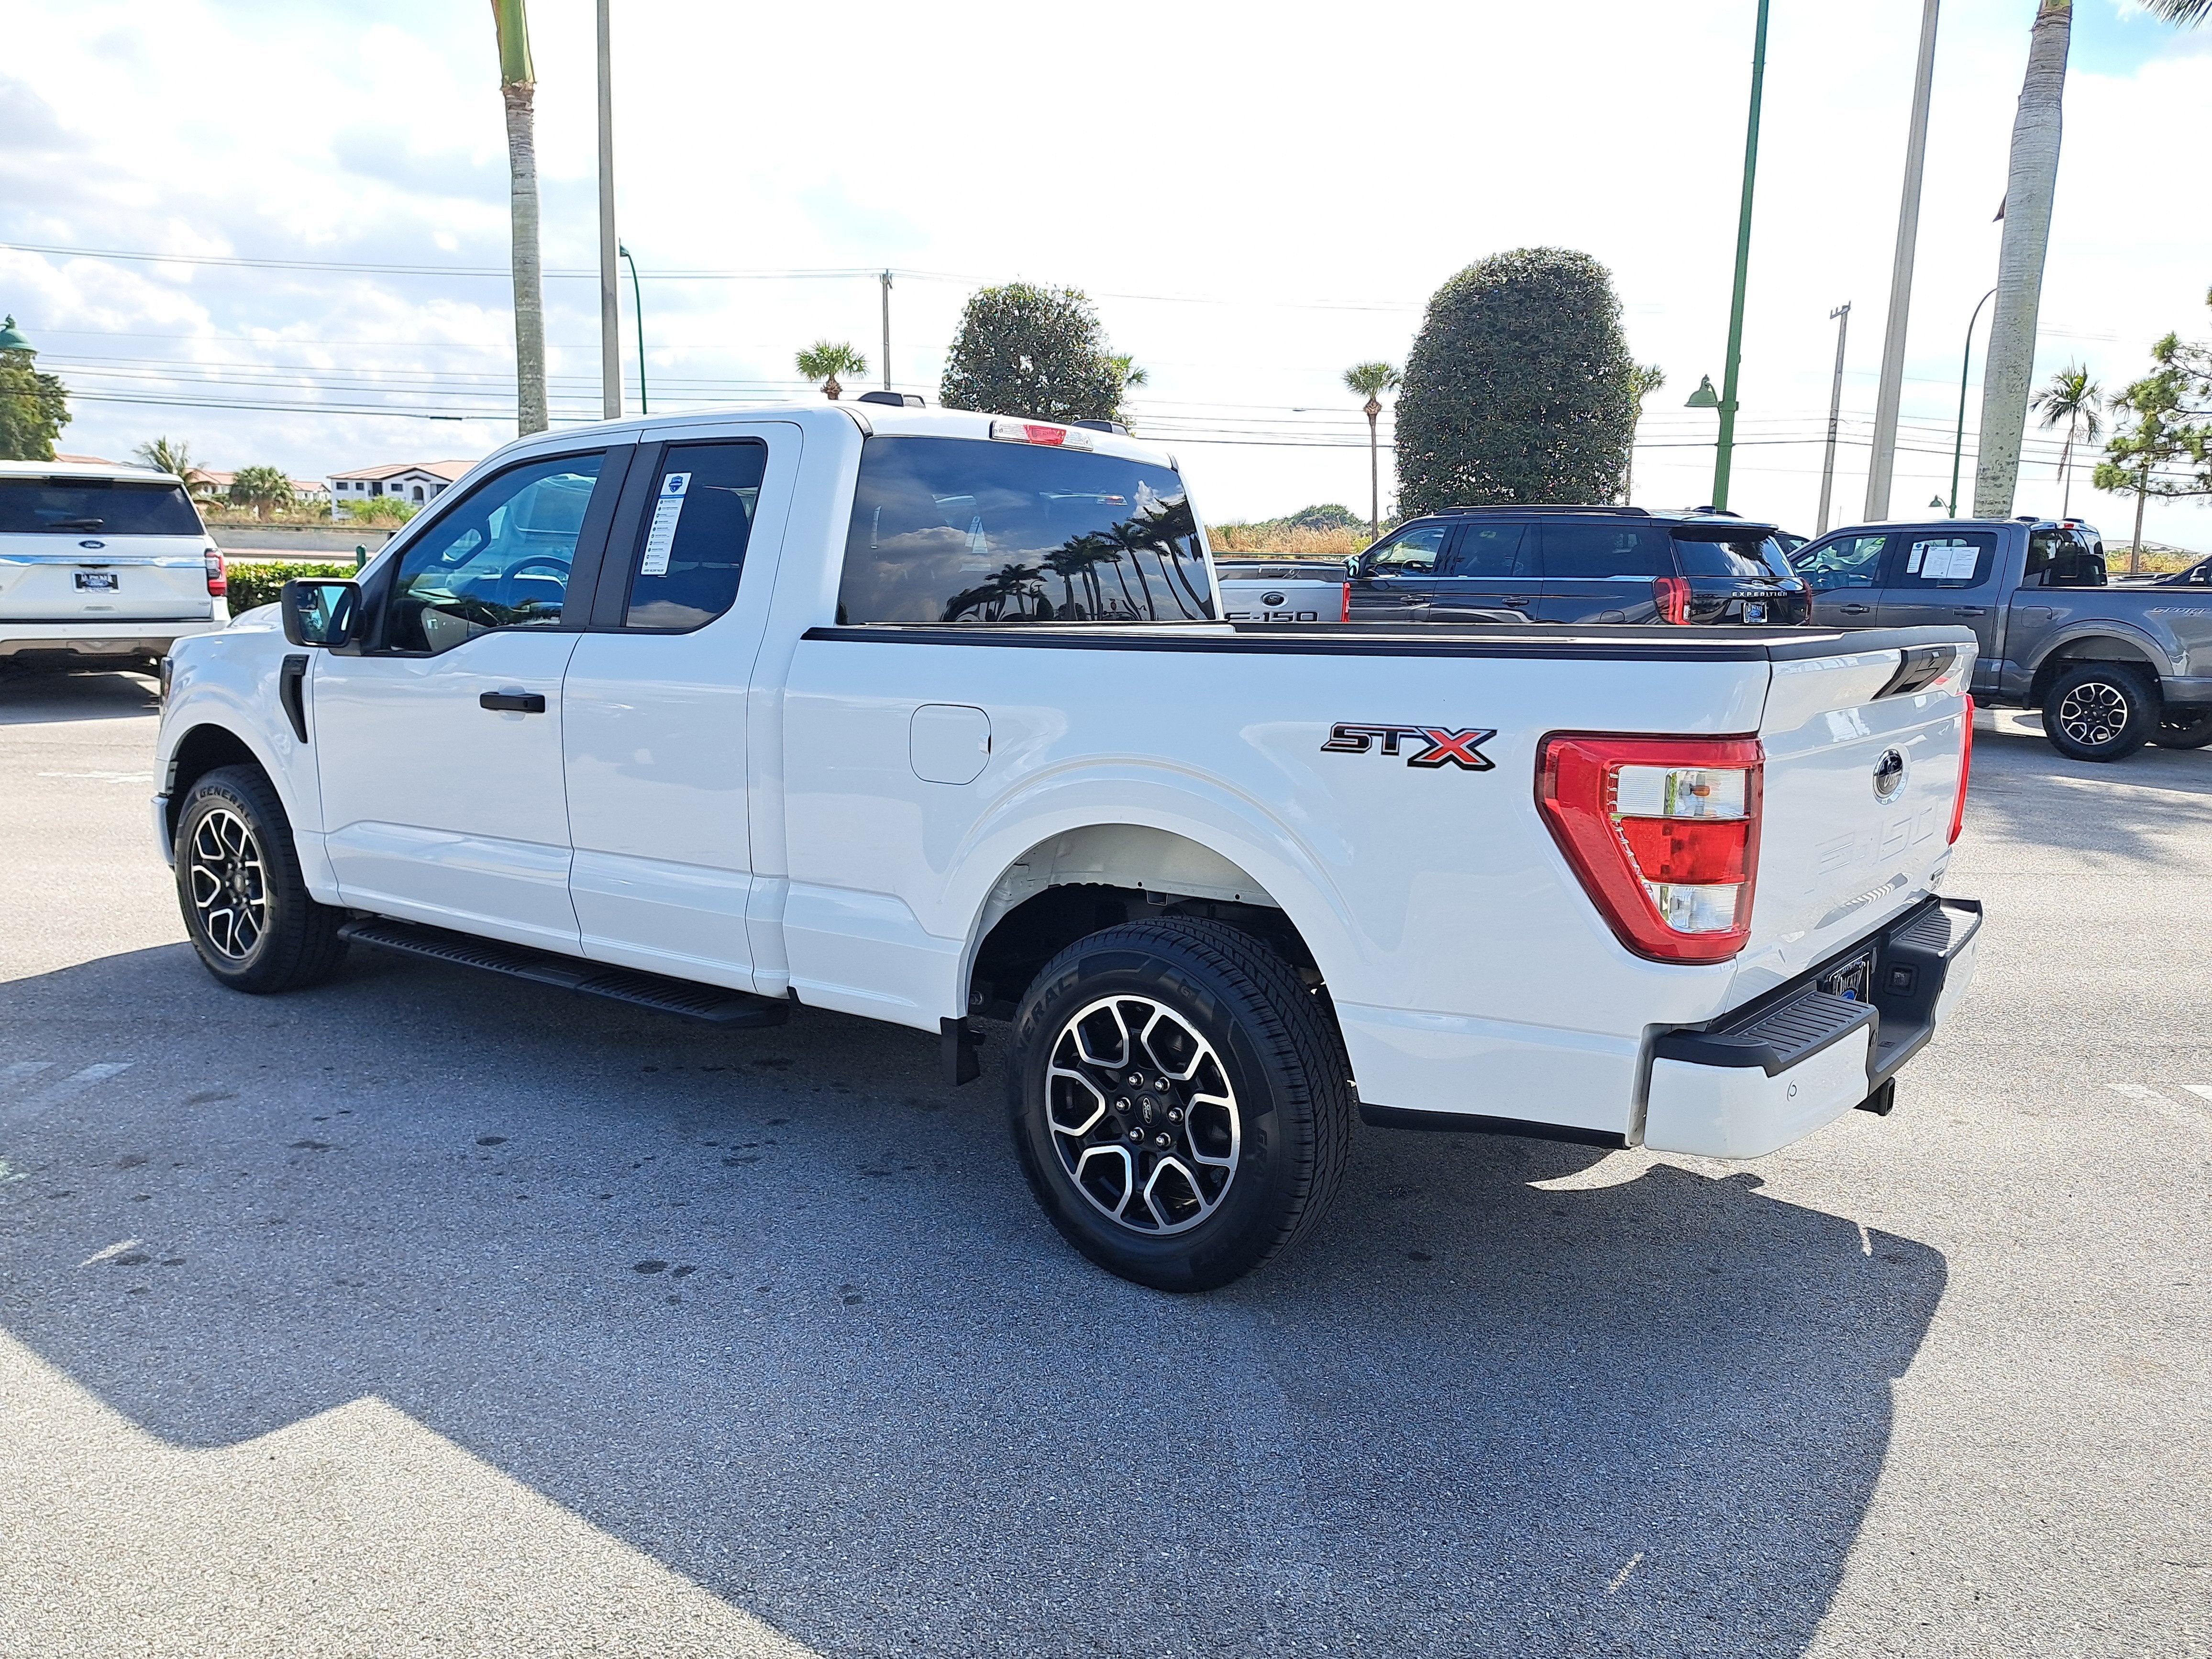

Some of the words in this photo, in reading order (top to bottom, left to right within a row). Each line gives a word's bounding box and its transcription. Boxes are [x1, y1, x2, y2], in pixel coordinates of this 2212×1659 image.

[1225, 611, 1318, 622] F-150
[1320, 722, 1497, 772] STX
[200, 785, 251, 824] GENERAL
